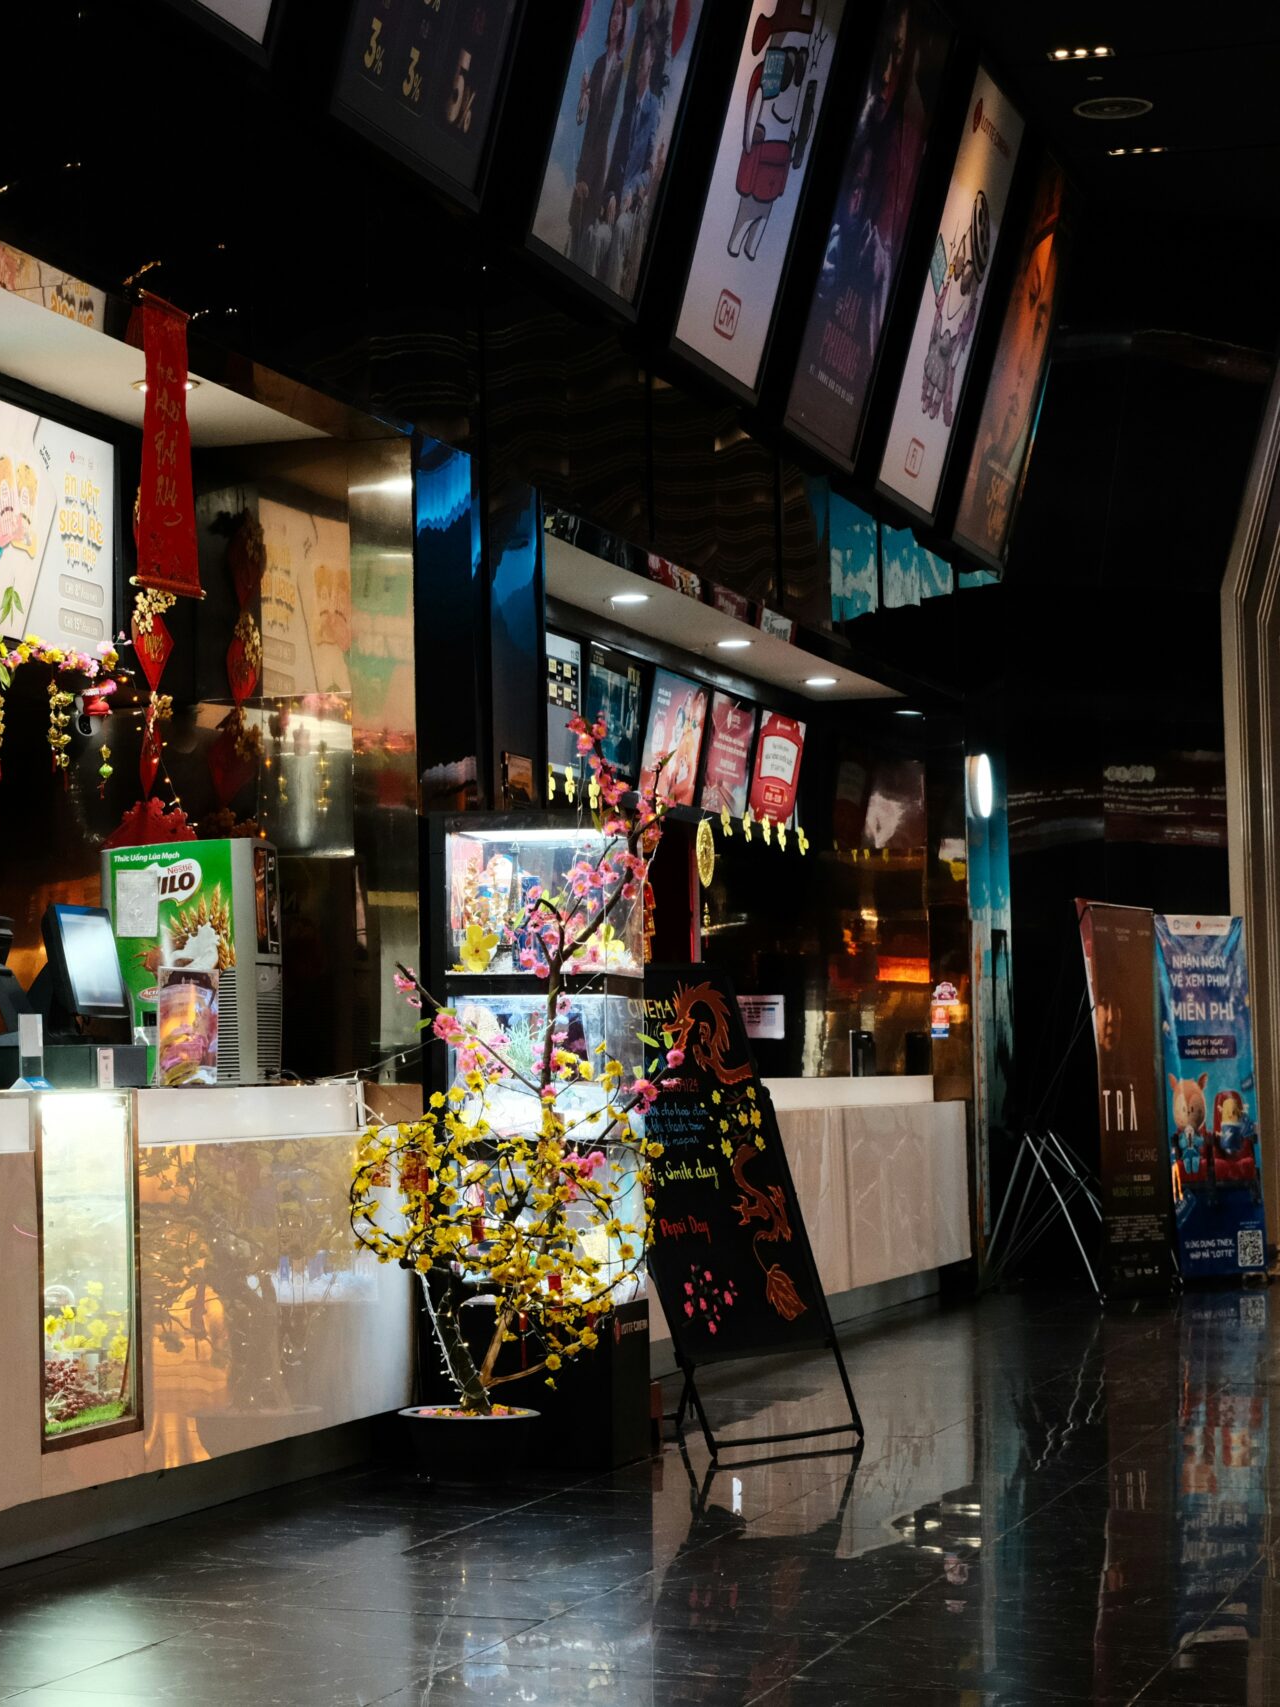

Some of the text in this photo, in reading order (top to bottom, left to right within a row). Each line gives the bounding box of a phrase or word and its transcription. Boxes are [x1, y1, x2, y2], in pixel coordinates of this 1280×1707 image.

[364, 17, 384, 75] 3%
[402, 46, 422, 102] 3%
[448, 48, 476, 133] 5%
[158, 872, 195, 895] ILO
[1201, 956, 1227, 968] NGAY
[1170, 971, 1230, 988] VÉ XEM PHIM
[1172, 991, 1206, 1021] MIỄN
[1102, 1083, 1138, 1131] TRÀ
[649, 1158, 719, 1190] ig Smile day
[659, 1215, 711, 1245] Pepsi Day
